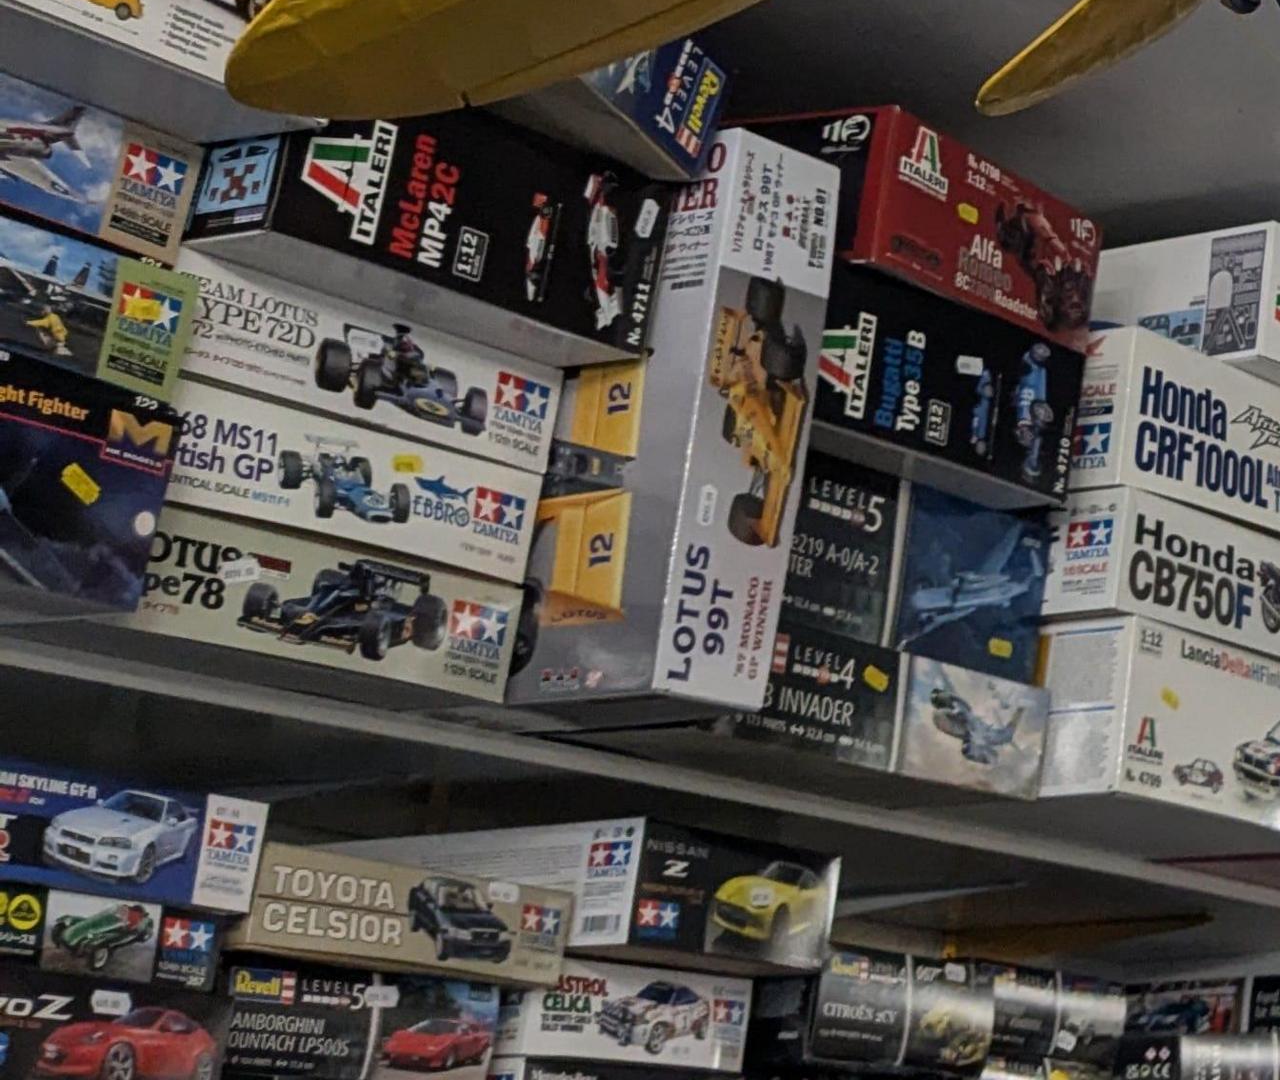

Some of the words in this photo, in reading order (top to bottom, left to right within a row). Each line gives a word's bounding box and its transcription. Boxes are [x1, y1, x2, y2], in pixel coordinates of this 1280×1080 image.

[119, 177, 178, 209] TAMIYA
[356, 126, 395, 238] ITALERI
[902, 160, 949, 193] ITALERI
[389, 133, 439, 260] McLaren
[969, 234, 1002, 269] Alfa
[249, 293, 319, 328] LOTUS
[631, 281, 650, 320] 4711
[198, 296, 261, 335] YPE
[264, 316, 316, 349] 72D
[850, 317, 875, 415] ITALERI
[28, 390, 91, 421] Fighter
[607, 380, 632, 415] 12
[1139, 365, 1229, 442] Honda
[214, 418, 278, 457] MS11
[494, 405, 542, 435] TAMIYA
[233, 454, 275, 483] GP
[1057, 436, 1072, 473] 4710
[1133, 420, 1269, 510] CRF1000L
[412, 494, 470, 528] EBBRO
[808, 476, 866, 512] LEVEL
[863, 495, 886, 533] 5
[471, 520, 520, 546] TAMIYA
[588, 531, 614, 568] 12
[1134, 513, 1256, 582] Honda
[150, 530, 243, 575] OTUS
[1065, 547, 1111, 562] TAMIYA
[143, 571, 226, 611] pe78
[1128, 550, 1255, 631] CB750F
[666, 543, 711, 683] LOTUS
[702, 579, 734, 656] 99T
[739, 575, 760, 650] MONACO
[752, 580, 773, 651] WINNER
[450, 637, 501, 661] TAMIYA
[793, 643, 842, 670] LEVEL
[839, 658, 857, 691] 4
[778, 686, 855, 728] INVADER
[205, 847, 252, 867] TAMIYA
[646, 839, 710, 860] NISSAN
[272, 864, 396, 911] TOYOTA
[661, 859, 691, 879] Z
[261, 902, 402, 947] CELSIOR
[301, 978, 351, 996] LEVEL
[350, 982, 367, 1011] 5
[542, 993, 593, 1014] CELICA
[556, 974, 610, 997] ASTROL
[230, 1011, 327, 1035] AMBORGHINI
